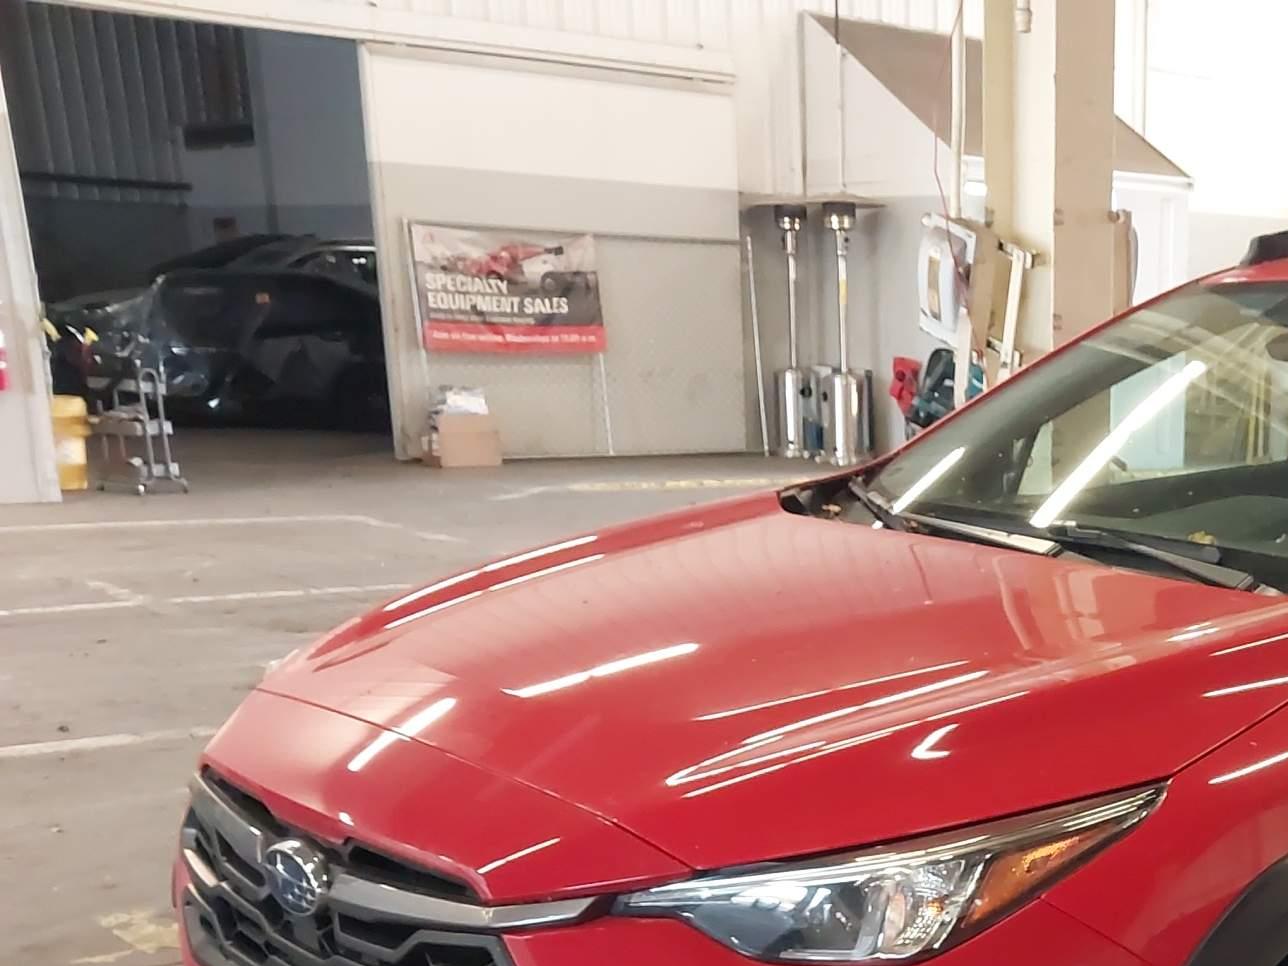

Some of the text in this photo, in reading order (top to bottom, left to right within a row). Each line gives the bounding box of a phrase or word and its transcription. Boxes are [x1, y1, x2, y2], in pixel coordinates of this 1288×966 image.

[425, 272, 508, 294] SPECIALTY
[427, 291, 569, 314] EQUIPMENT SALES
